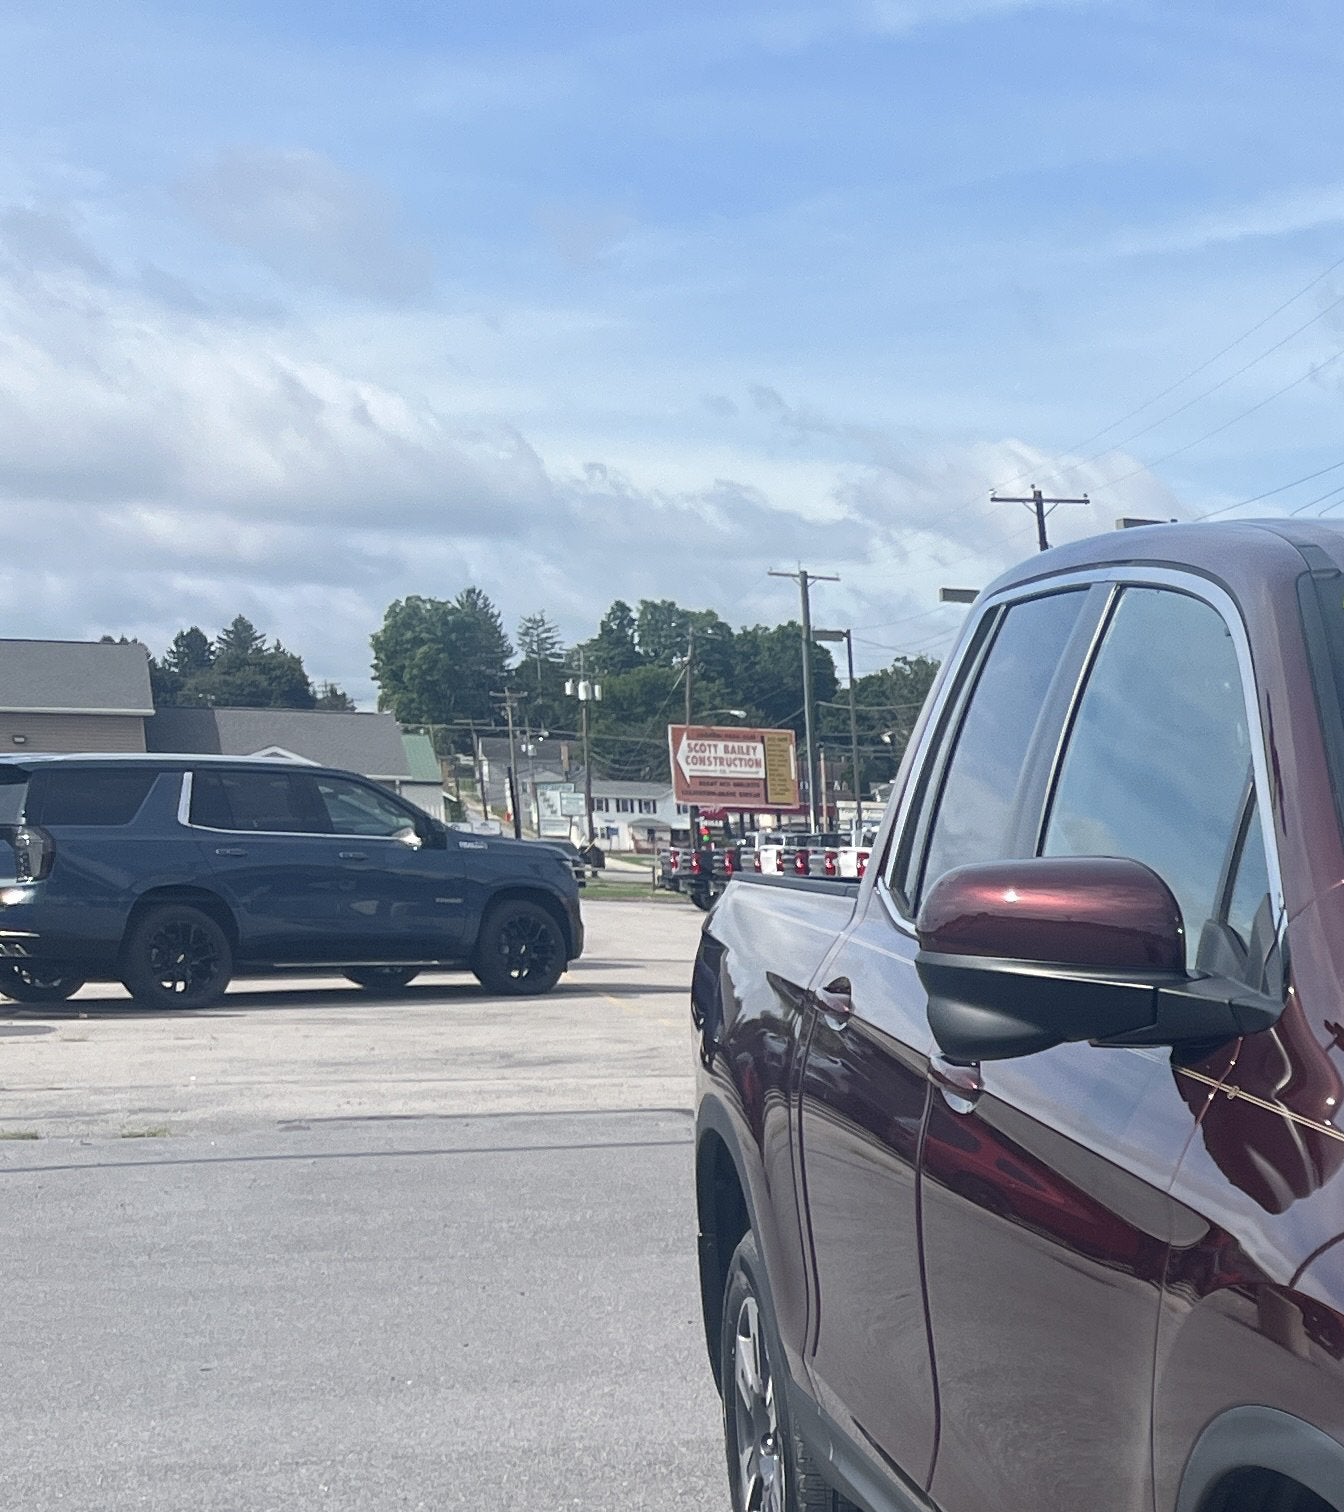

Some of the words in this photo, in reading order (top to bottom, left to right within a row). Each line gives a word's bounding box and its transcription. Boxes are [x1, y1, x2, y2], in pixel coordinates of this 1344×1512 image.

[687, 742, 718, 754] SCOTT
[723, 744, 757, 756] BAILEY
[685, 755, 762, 768] CONSTRUCTION
